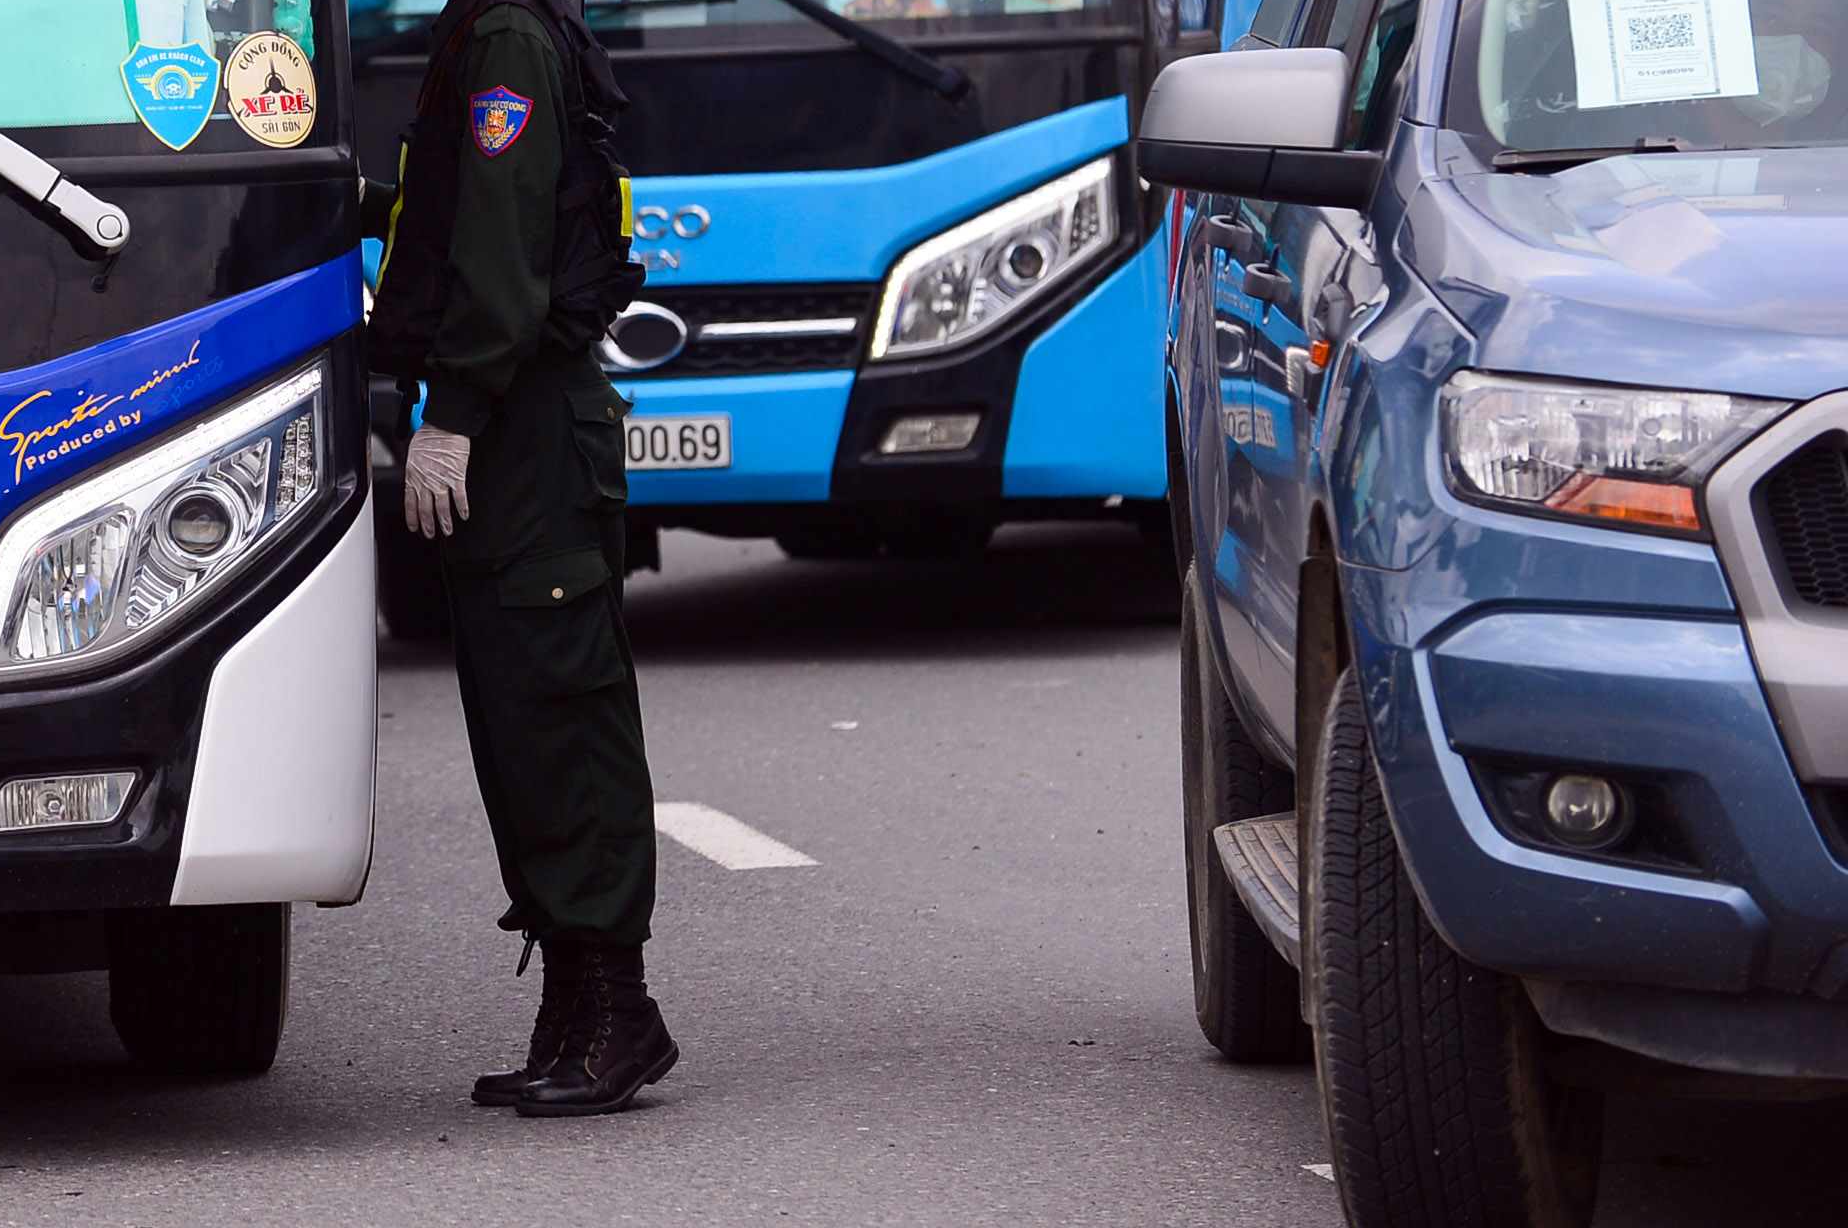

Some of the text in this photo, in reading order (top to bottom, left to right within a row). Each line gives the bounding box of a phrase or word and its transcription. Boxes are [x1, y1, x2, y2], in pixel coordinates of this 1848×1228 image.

[242, 87, 309, 116] XE RẺ
[262, 118, 301, 133] SÀI GÒN
[24, 418, 117, 471] Produced
[118, 409, 142, 426] by
